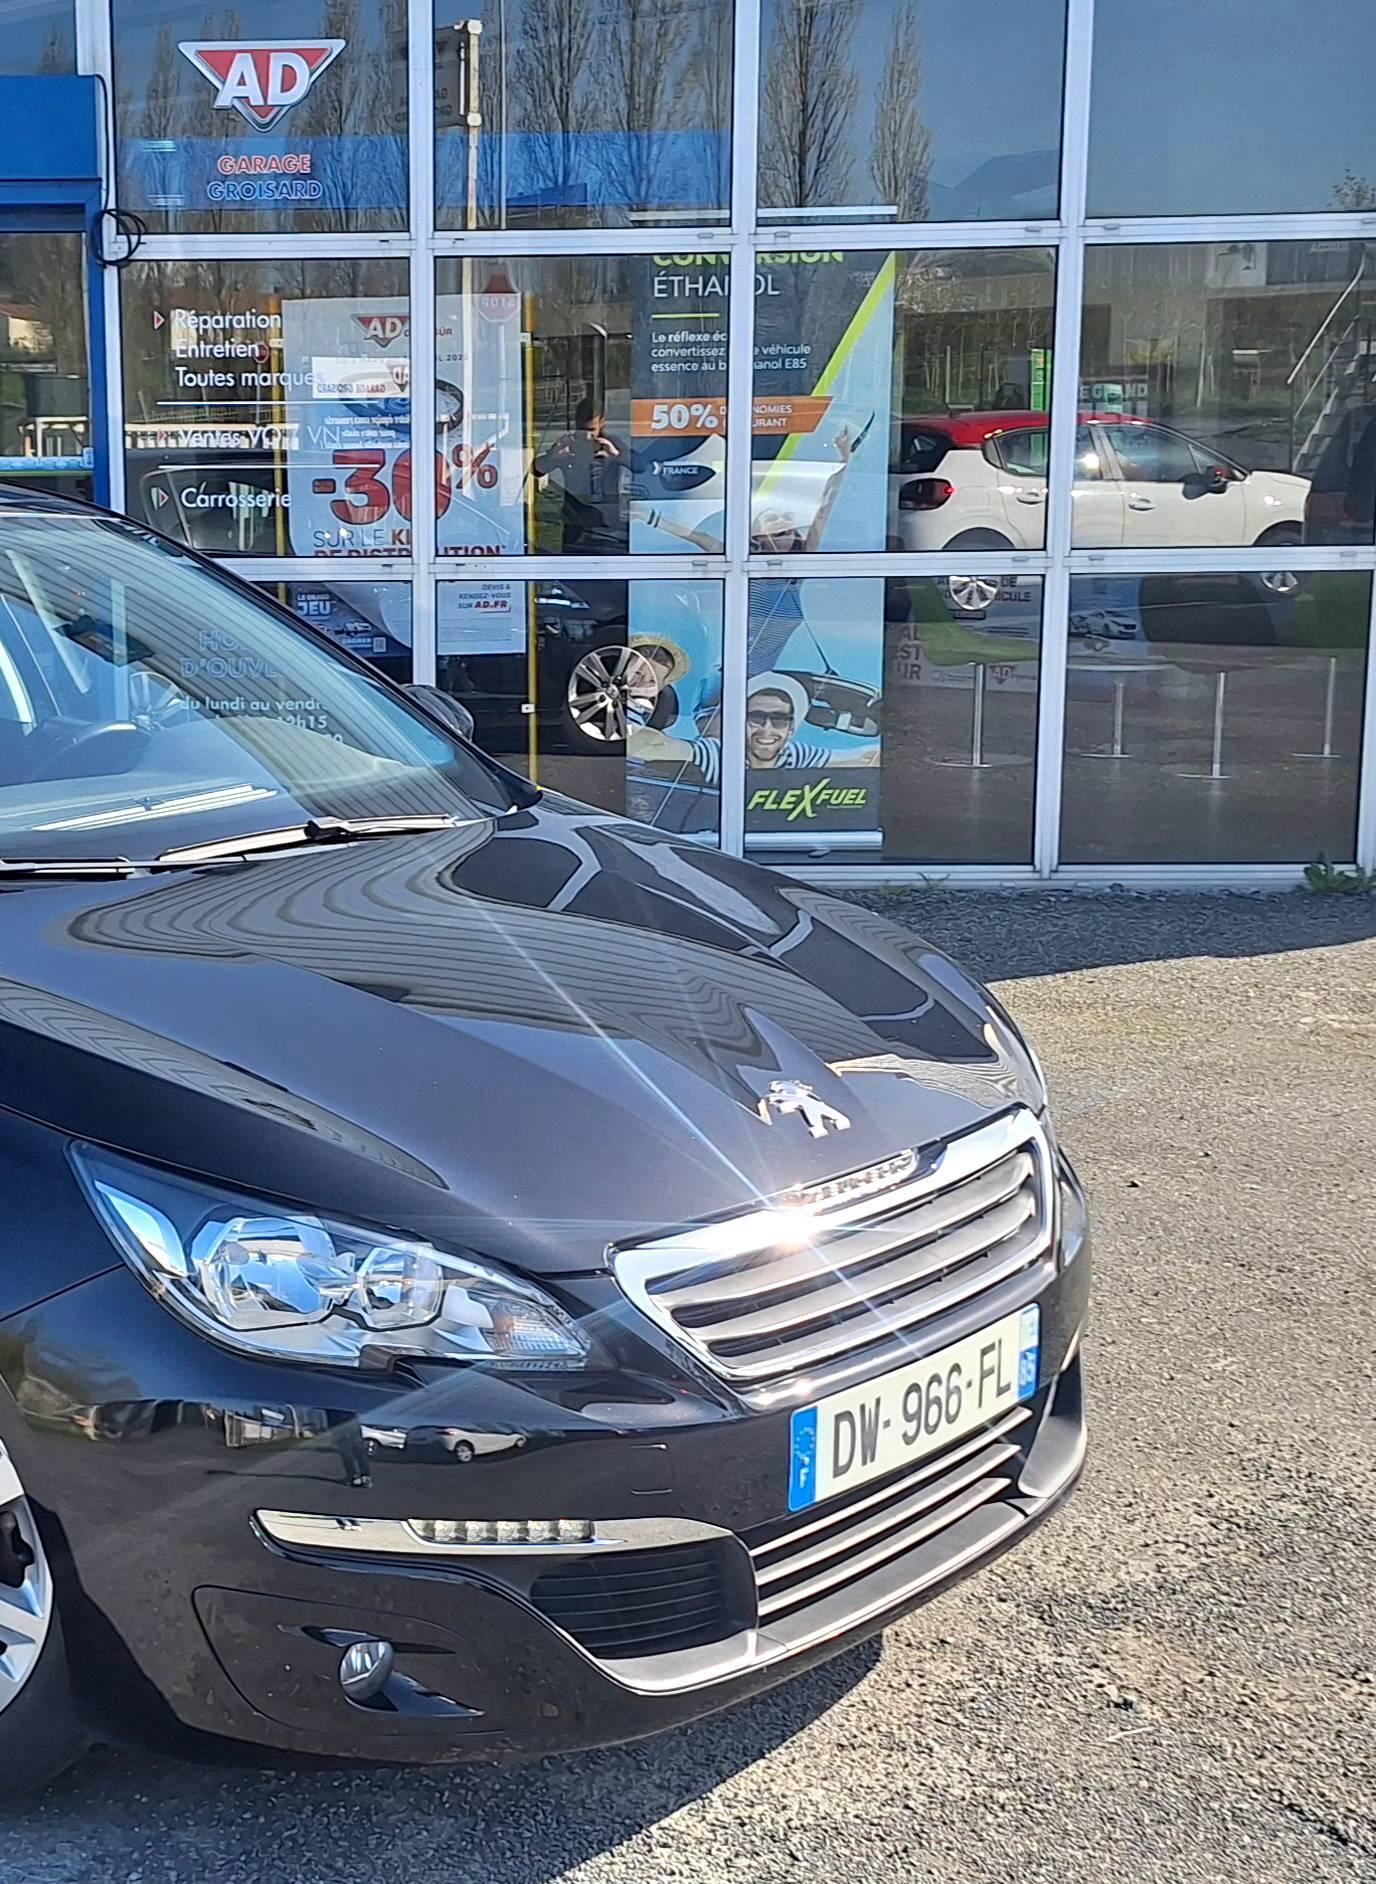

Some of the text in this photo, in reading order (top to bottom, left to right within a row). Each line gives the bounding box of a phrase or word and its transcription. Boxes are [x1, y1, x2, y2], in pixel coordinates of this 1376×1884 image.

[213, 51, 311, 109] AD
[217, 154, 311, 174] GARAGE
[207, 180, 323, 200] GROISARD
[654, 271, 780, 298] ÉTHAOL
[174, 308, 281, 335] Réparation
[364, 317, 403, 339] AD
[652, 333, 666, 343] Le
[668, 331, 711, 342] réflexe
[176, 338, 259, 358] Entretien
[651, 345, 726, 357] convertissez
[763, 344, 811, 355] véhicule
[651, 362, 699, 372] essence
[702, 362, 715, 371] au
[785, 359, 807, 369] E85
[174, 367, 324, 391] Toutes marques
[651, 404, 718, 429] 50%
[179, 427, 241, 445] Ventes
[307, 425, 340, 444] VN
[663, 467, 698, 476] FRANCE
[181, 487, 292, 508] Carrosserie
[313, 529, 354, 548] SUR
[362, 528, 384, 547] LE
[297, 600, 331, 615] JEU
[474, 600, 508, 608] AD.FR
[181, 696, 199, 710] du
[205, 696, 244, 710] lundi
[250, 700, 270, 710] au
